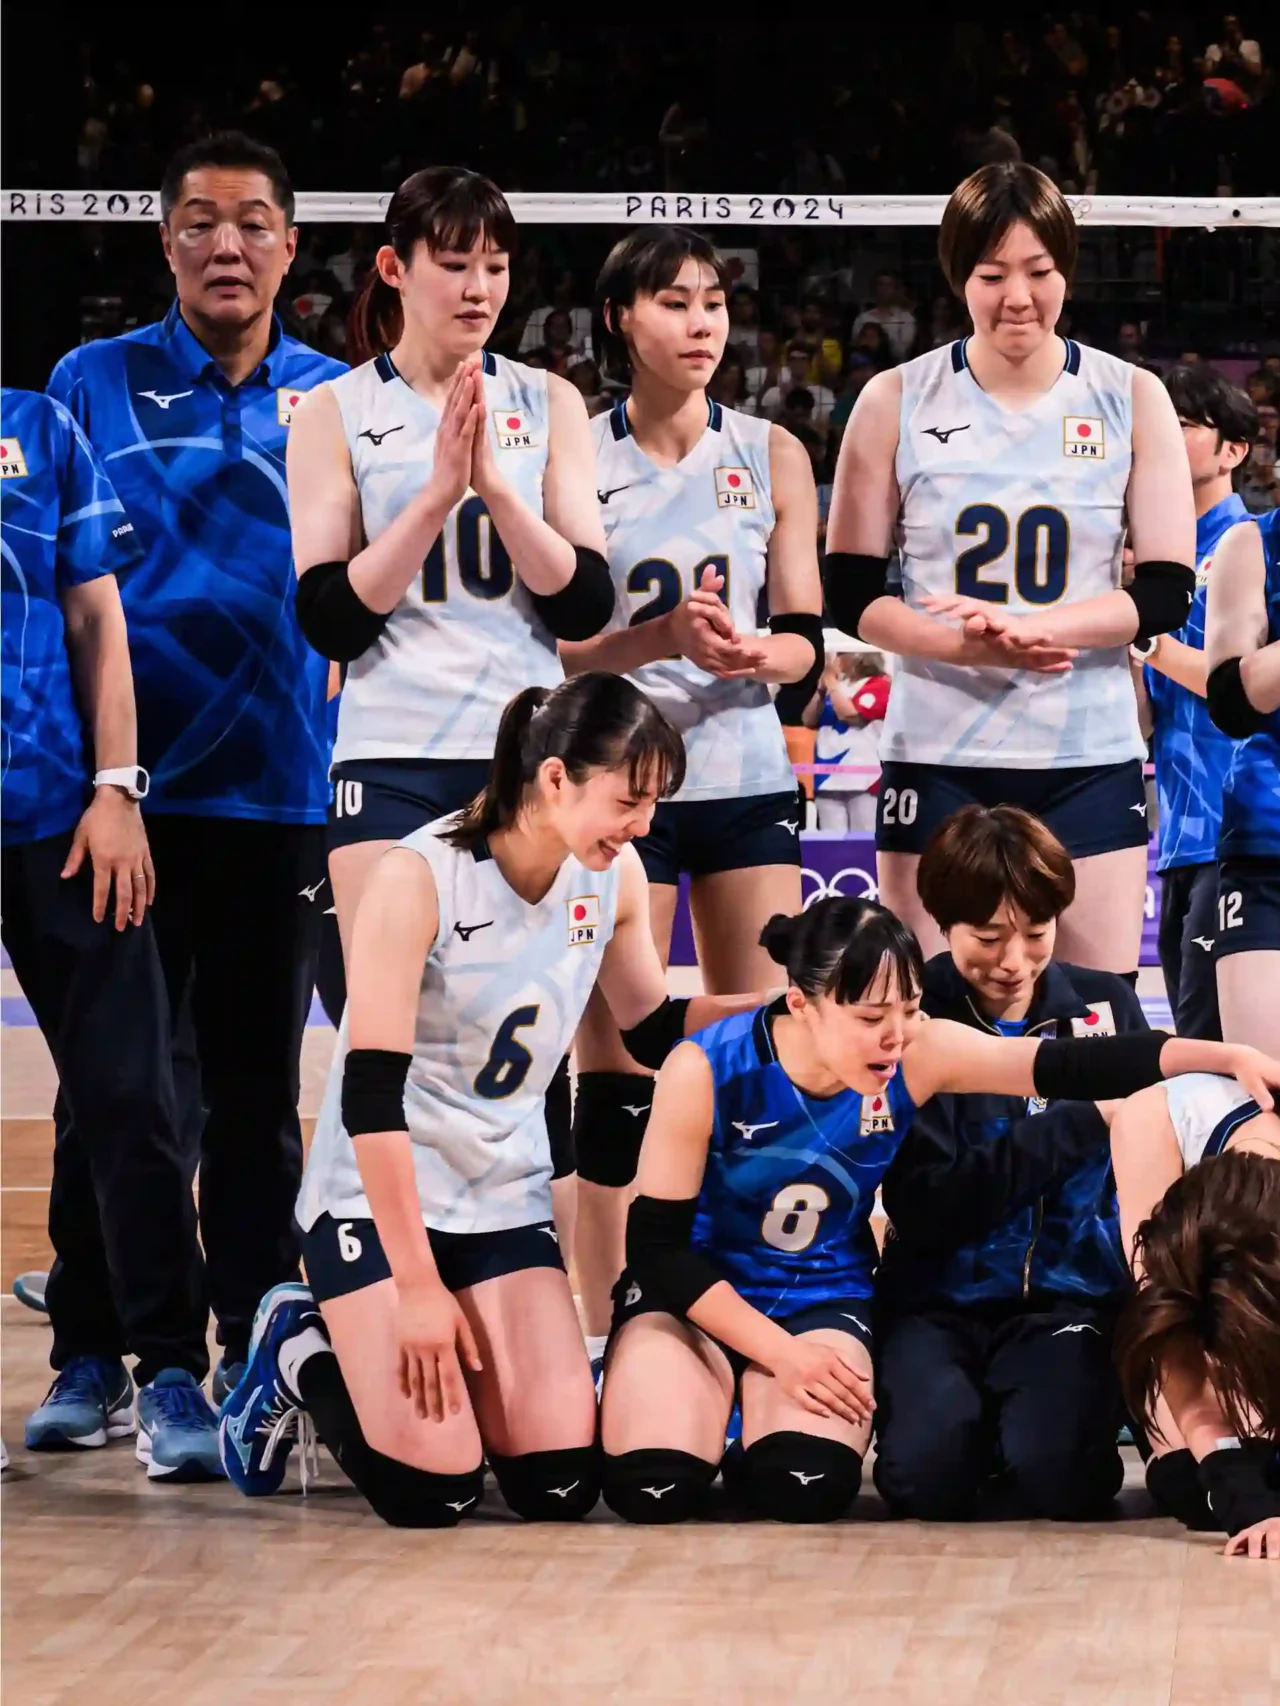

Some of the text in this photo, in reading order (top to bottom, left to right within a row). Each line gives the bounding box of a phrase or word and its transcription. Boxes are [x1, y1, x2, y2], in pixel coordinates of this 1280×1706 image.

[10, 192, 155, 217] RiS 202
[749, 196, 844, 220] 2024
[505, 435, 531, 447] JPN
[1071, 444, 1097, 456] JPN
[2, 463, 20, 476] PN
[724, 493, 748, 507] JPN
[954, 502, 1071, 607] 20
[336, 779, 363, 818] 10
[883, 787, 919, 826] 20
[1217, 890, 1244, 932] 12
[570, 928, 594, 943] JPN
[472, 1003, 541, 1100] 6
[761, 1183, 830, 1252] 8
[337, 1222, 363, 1262] 6
